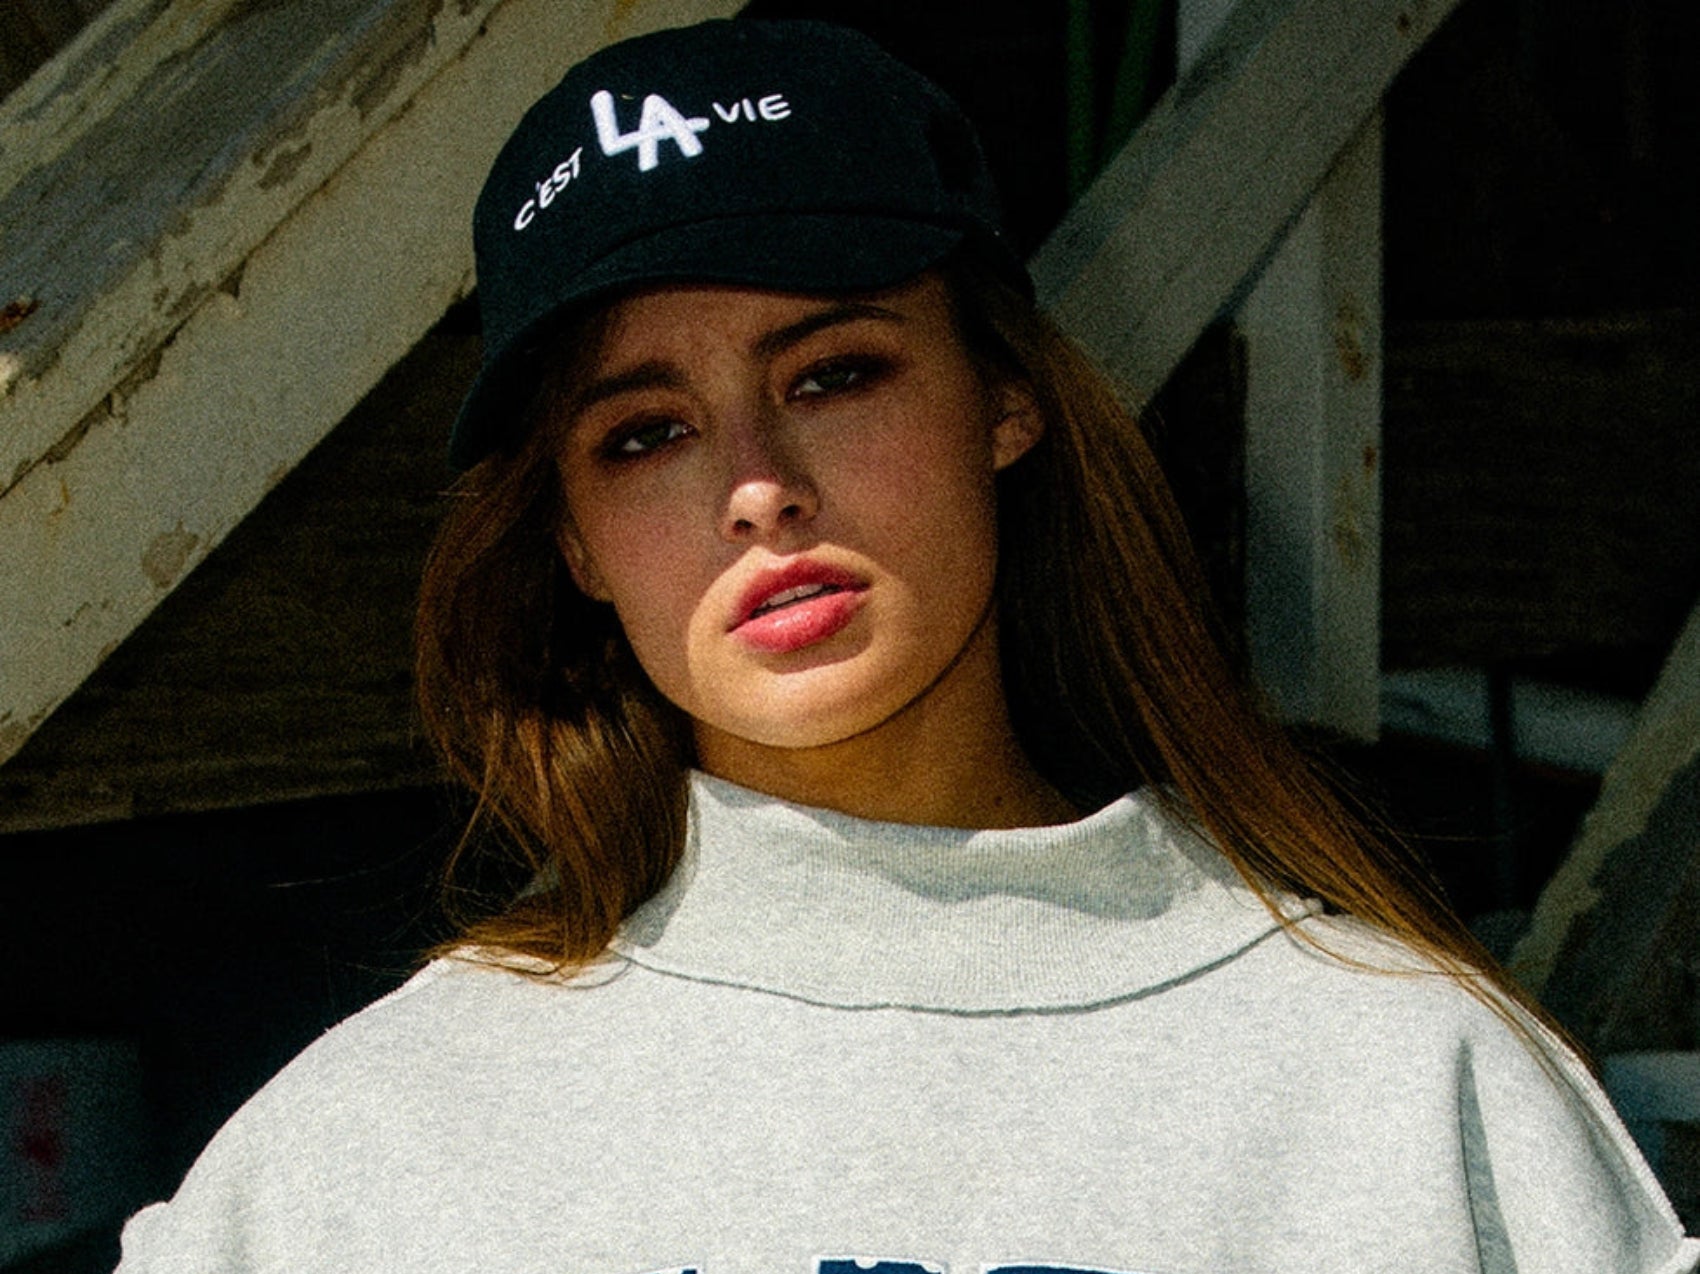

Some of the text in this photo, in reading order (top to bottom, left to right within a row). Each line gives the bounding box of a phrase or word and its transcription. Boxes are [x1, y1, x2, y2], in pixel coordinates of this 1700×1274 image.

[514, 89, 792, 231] C'EST LA VIE
